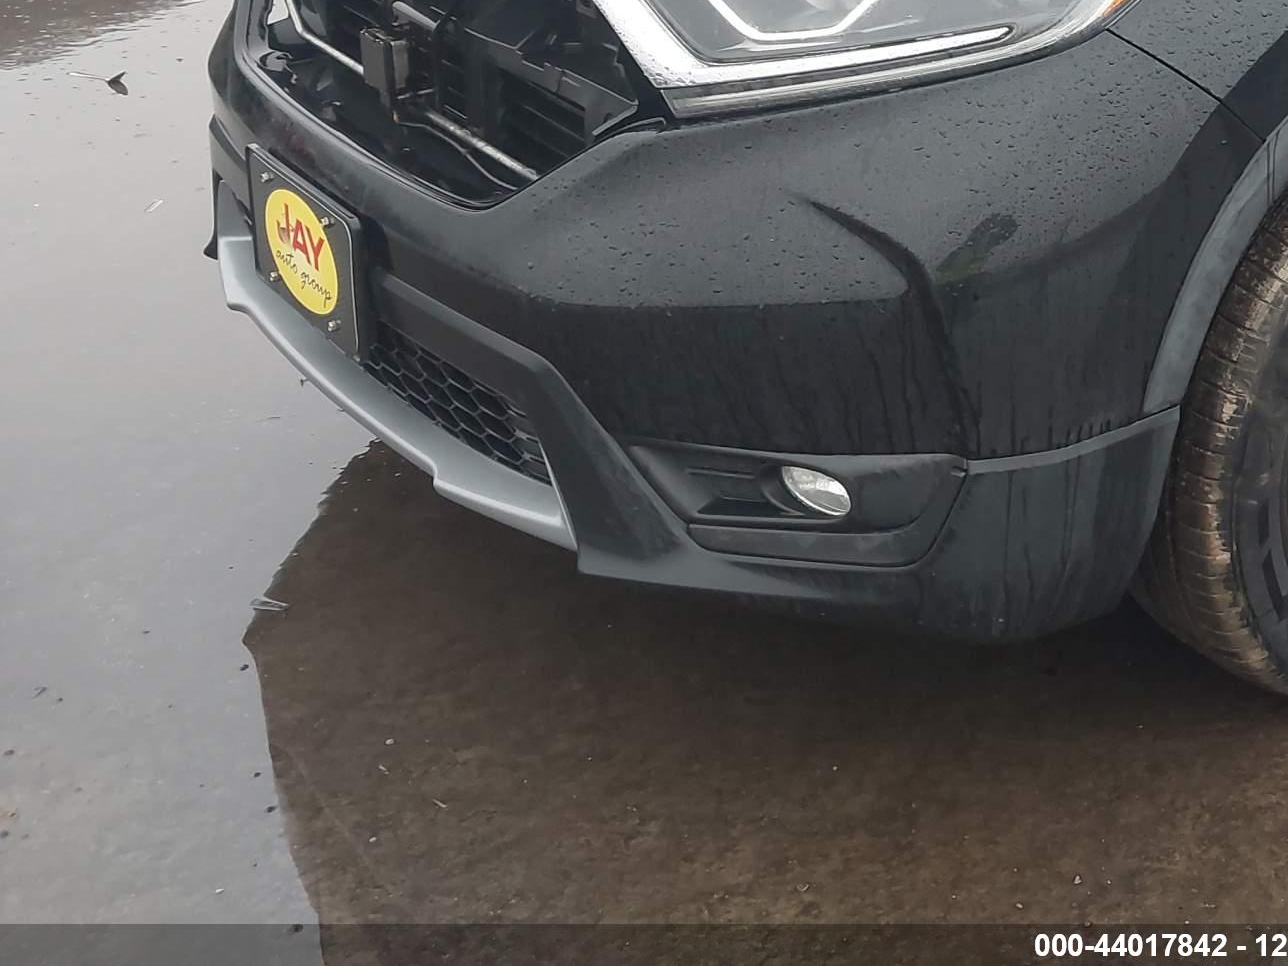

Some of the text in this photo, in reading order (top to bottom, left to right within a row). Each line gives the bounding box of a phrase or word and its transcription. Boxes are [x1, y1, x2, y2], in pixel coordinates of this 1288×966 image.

[275, 202, 325, 271] JAY
[275, 249, 333, 308] auto group
